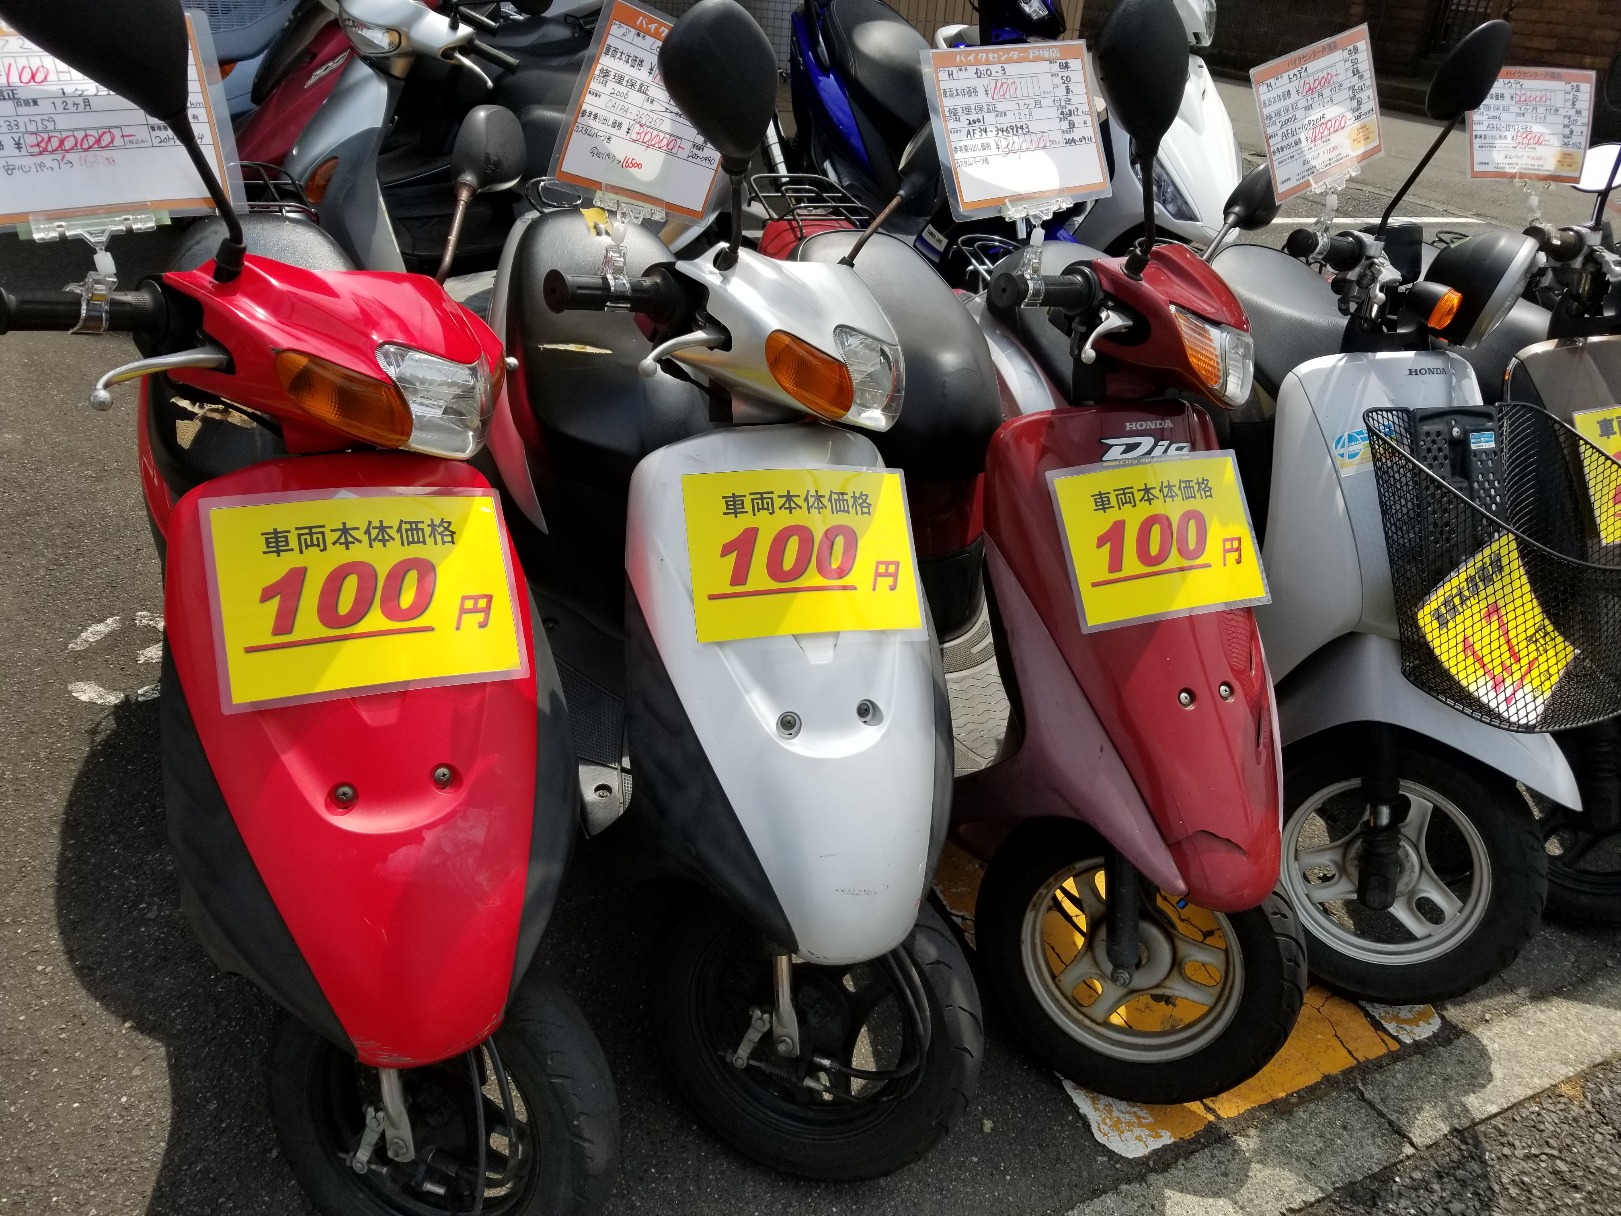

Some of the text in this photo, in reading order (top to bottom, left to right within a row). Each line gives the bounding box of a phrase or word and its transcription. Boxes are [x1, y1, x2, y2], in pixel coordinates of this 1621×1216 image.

[603, 43, 645, 71] 車両本体価格
[956, 47, 1061, 63] バイクセンター戸塚店
[598, 66, 651, 97] 修理保証
[609, 86, 630, 100] 2006
[941, 85, 979, 99] 車両本体価格
[947, 103, 998, 116] 修理保証
[621, 155, 643, 170] 16500
[1407, 366, 1448, 376] HONDA
[1125, 419, 1174, 431] HONDA
[721, 489, 872, 518] 車両本体価格
[1090, 477, 1214, 513] 車両本体価格
[260, 517, 457, 557] 車両本体価格
[1095, 508, 1242, 574] 100 円
[719, 523, 900, 592] 100 円
[258, 556, 493, 636] 100 円
